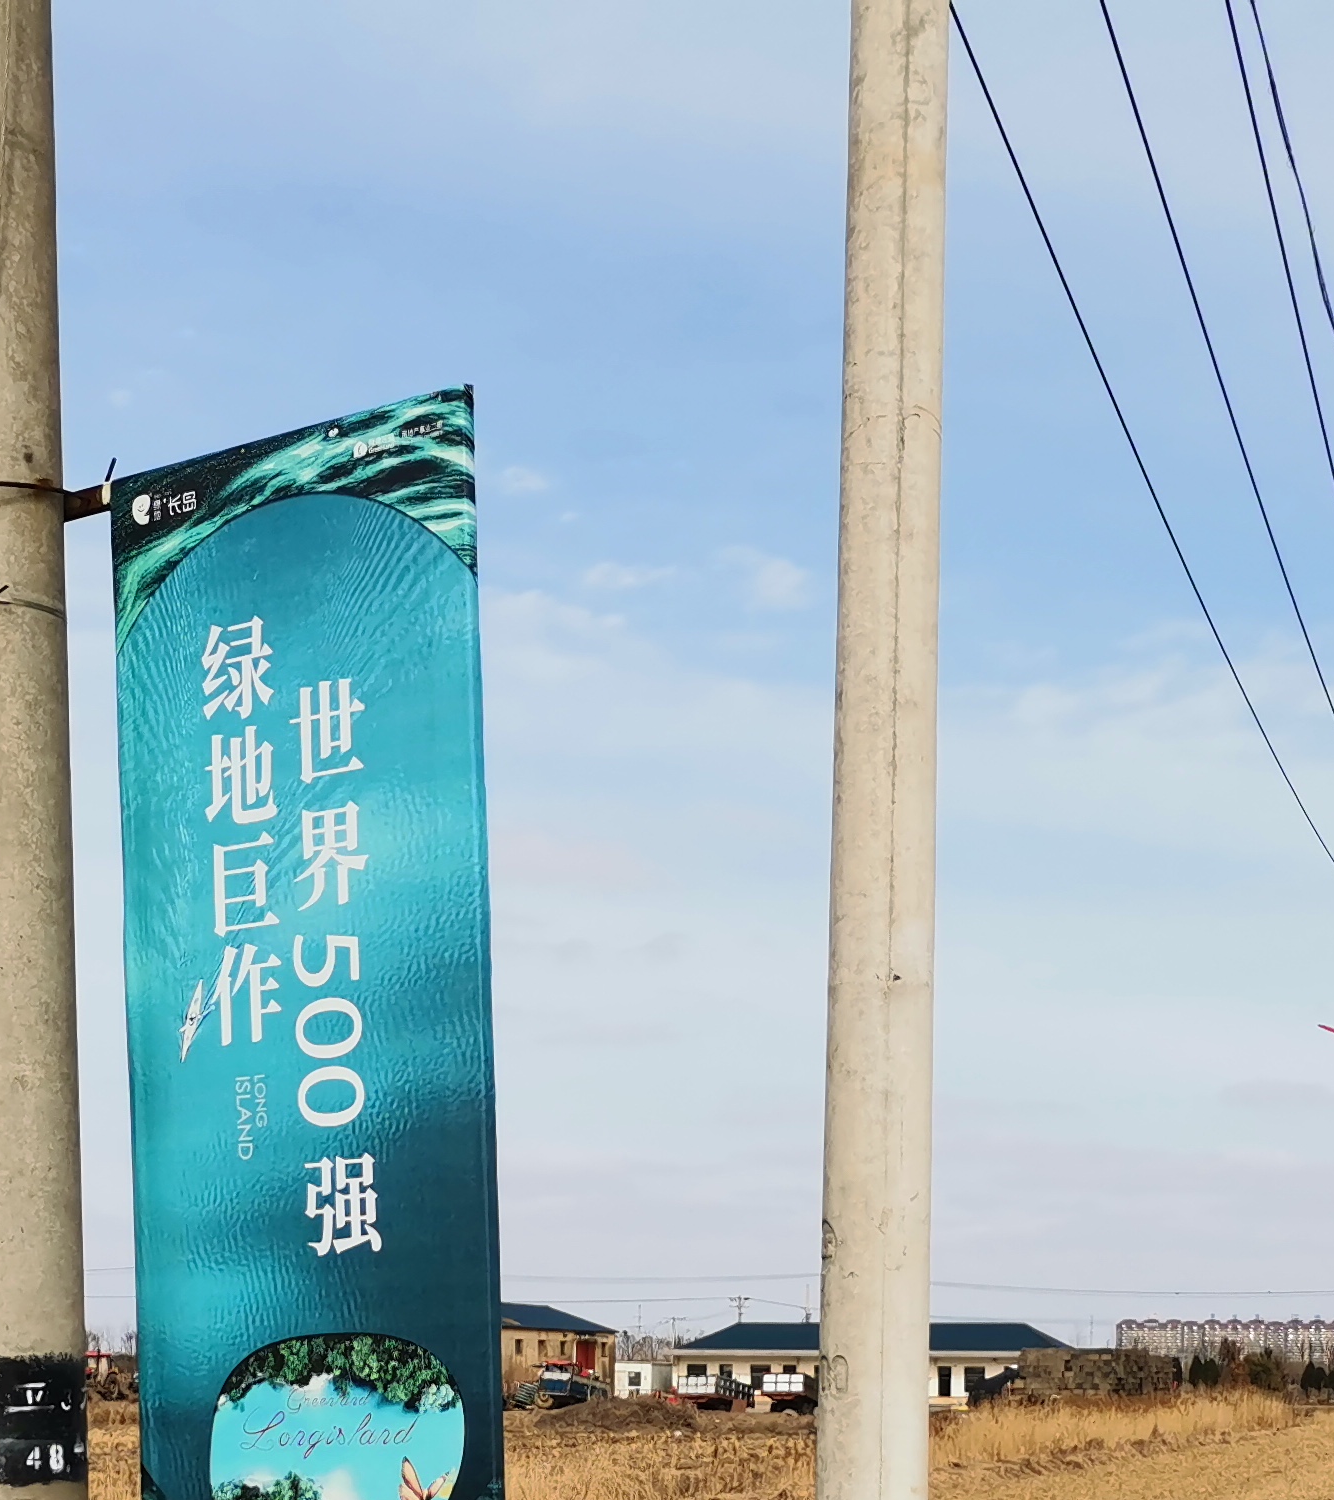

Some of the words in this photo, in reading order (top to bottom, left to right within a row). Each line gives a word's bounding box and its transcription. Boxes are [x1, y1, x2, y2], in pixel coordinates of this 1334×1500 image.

[168, 490, 197, 516] 长岛
[201, 615, 282, 1046] 绿地巨作
[289, 678, 382, 1257] 世界500强
[235, 1076, 254, 1161] ISLAND
[254, 1074, 268, 1128] LONG
